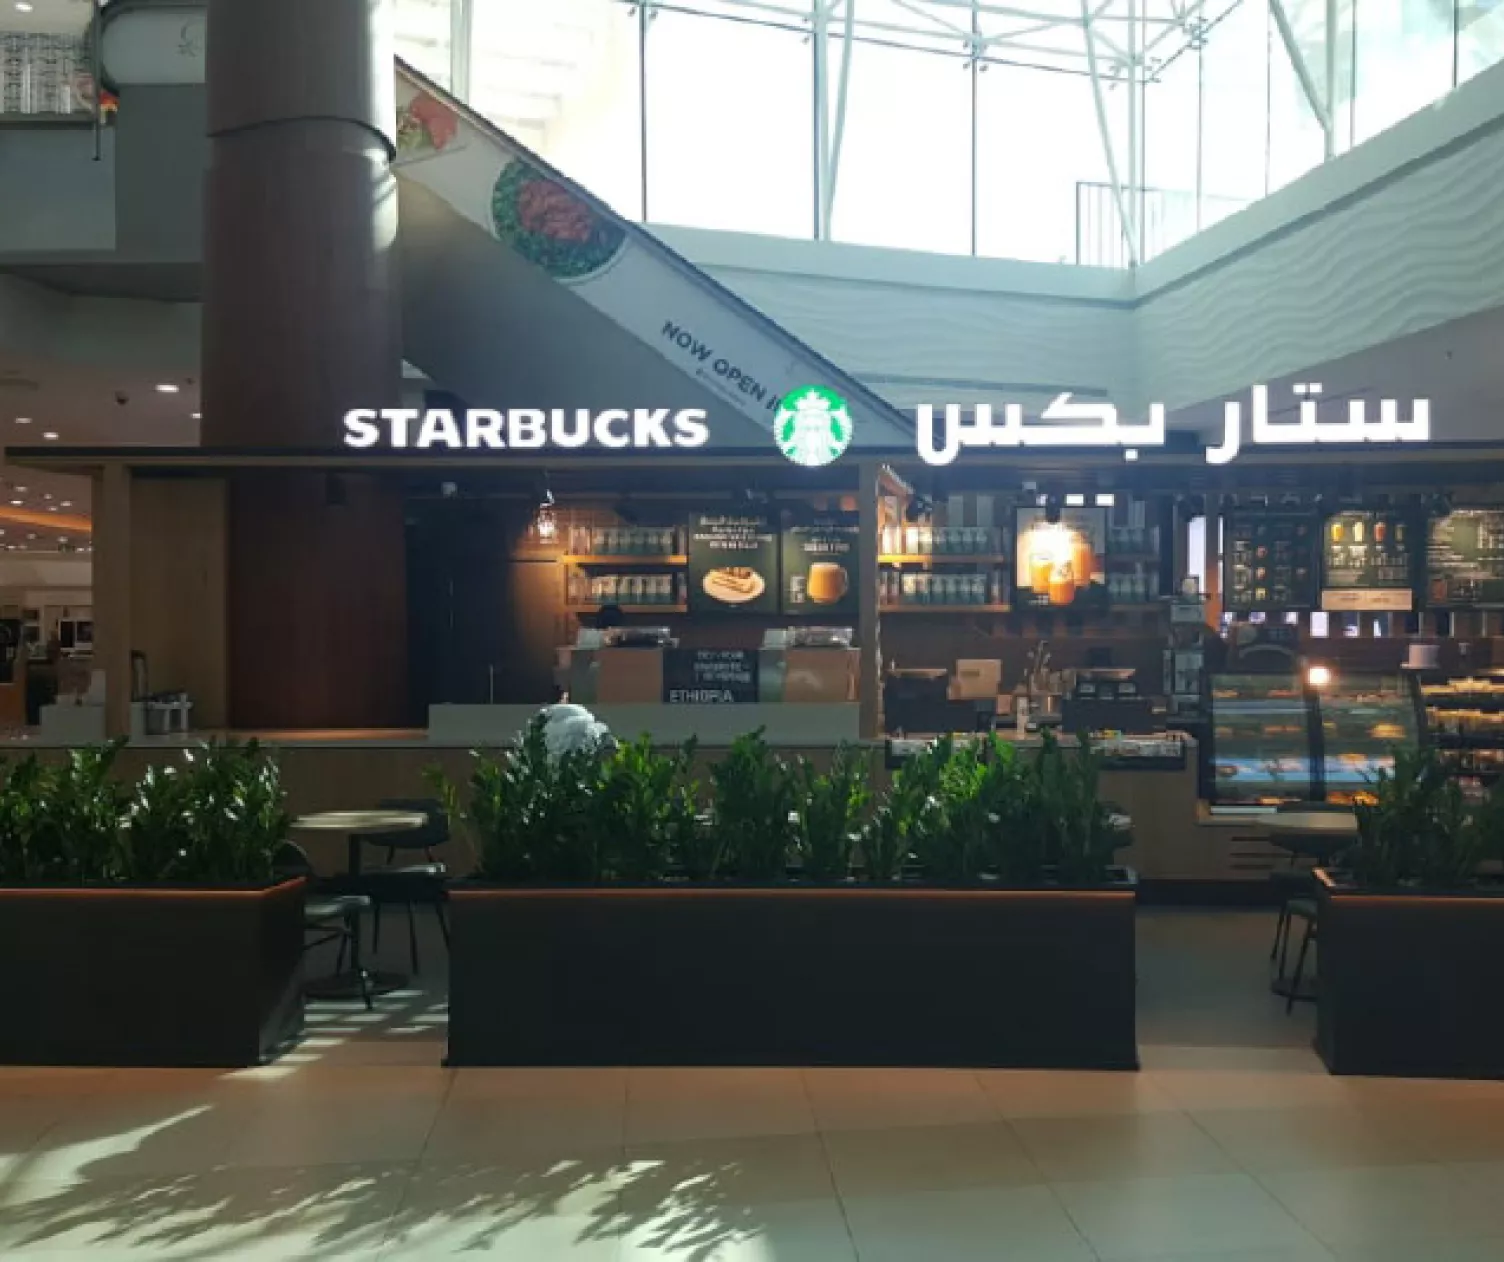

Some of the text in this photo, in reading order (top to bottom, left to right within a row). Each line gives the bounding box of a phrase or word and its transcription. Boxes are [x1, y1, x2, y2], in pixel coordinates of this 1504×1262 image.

[662, 320, 713, 363] NOW
[712, 358, 769, 402] OPEN
[344, 407, 709, 448] STARBUCKS
[915, 382, 1430, 466] ستار بكس
